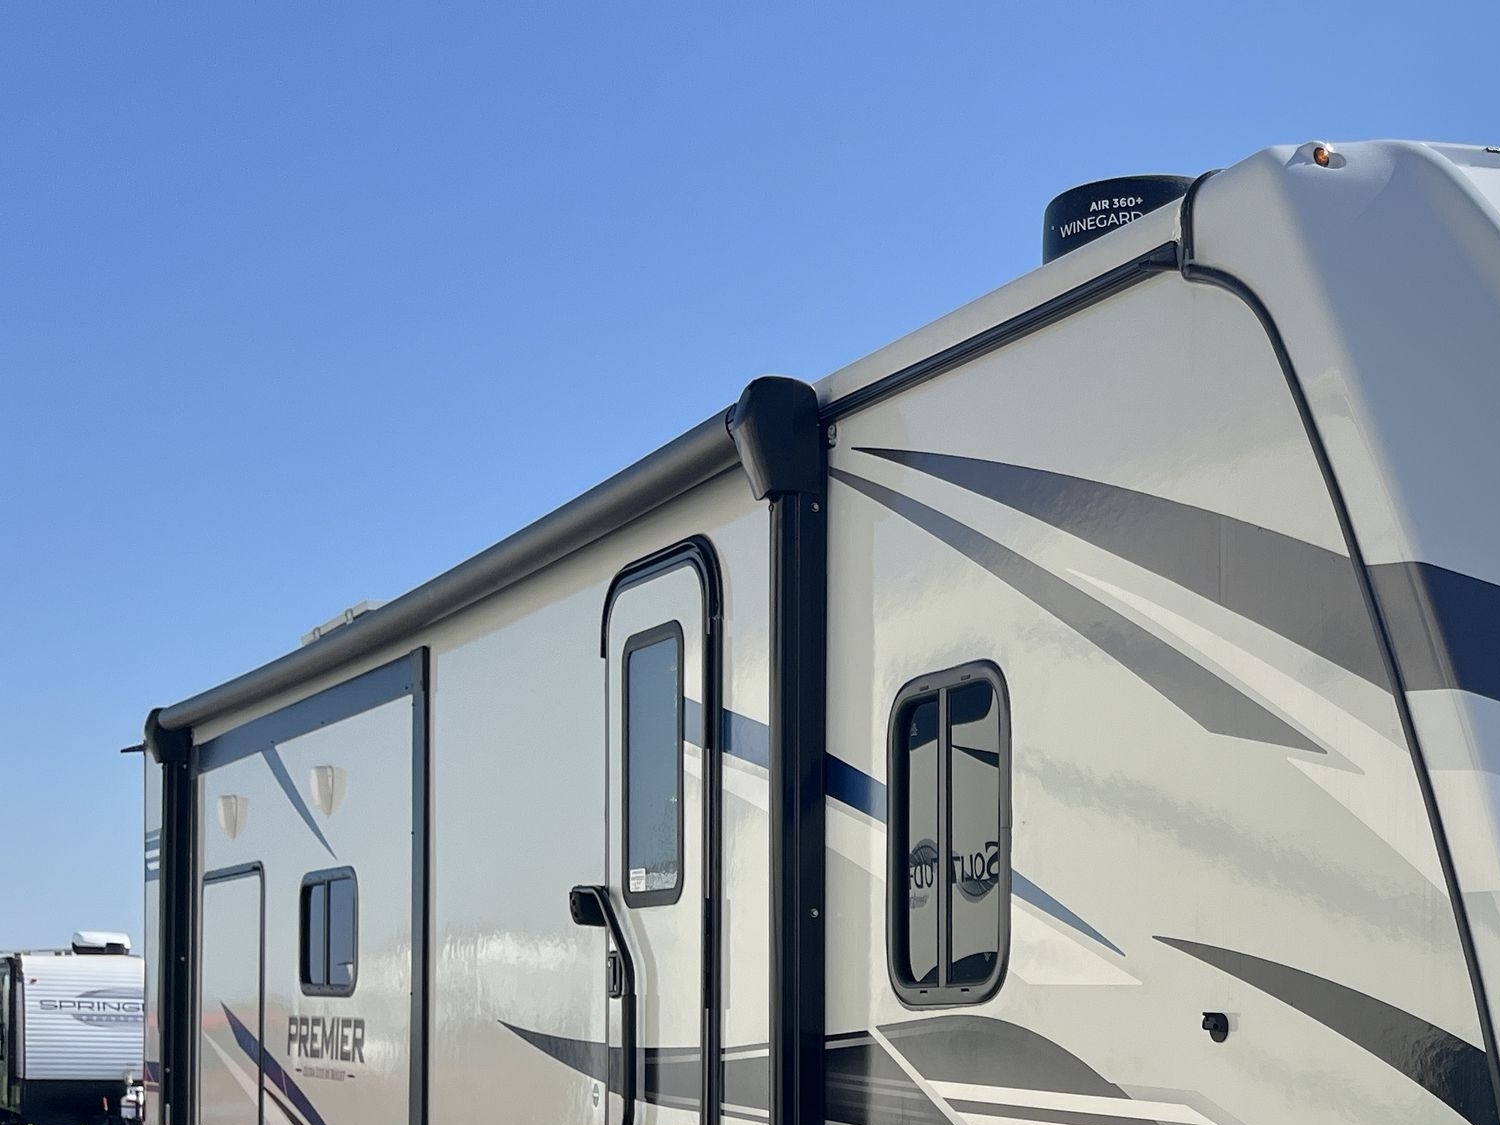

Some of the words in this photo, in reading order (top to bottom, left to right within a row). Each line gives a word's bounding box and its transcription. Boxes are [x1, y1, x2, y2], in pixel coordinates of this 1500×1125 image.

[1089, 200, 1110, 212] AIR
[1112, 197, 1144, 209] 360+
[40, 1000, 145, 1012] SPRING
[287, 1016, 365, 1064] PREMIER
